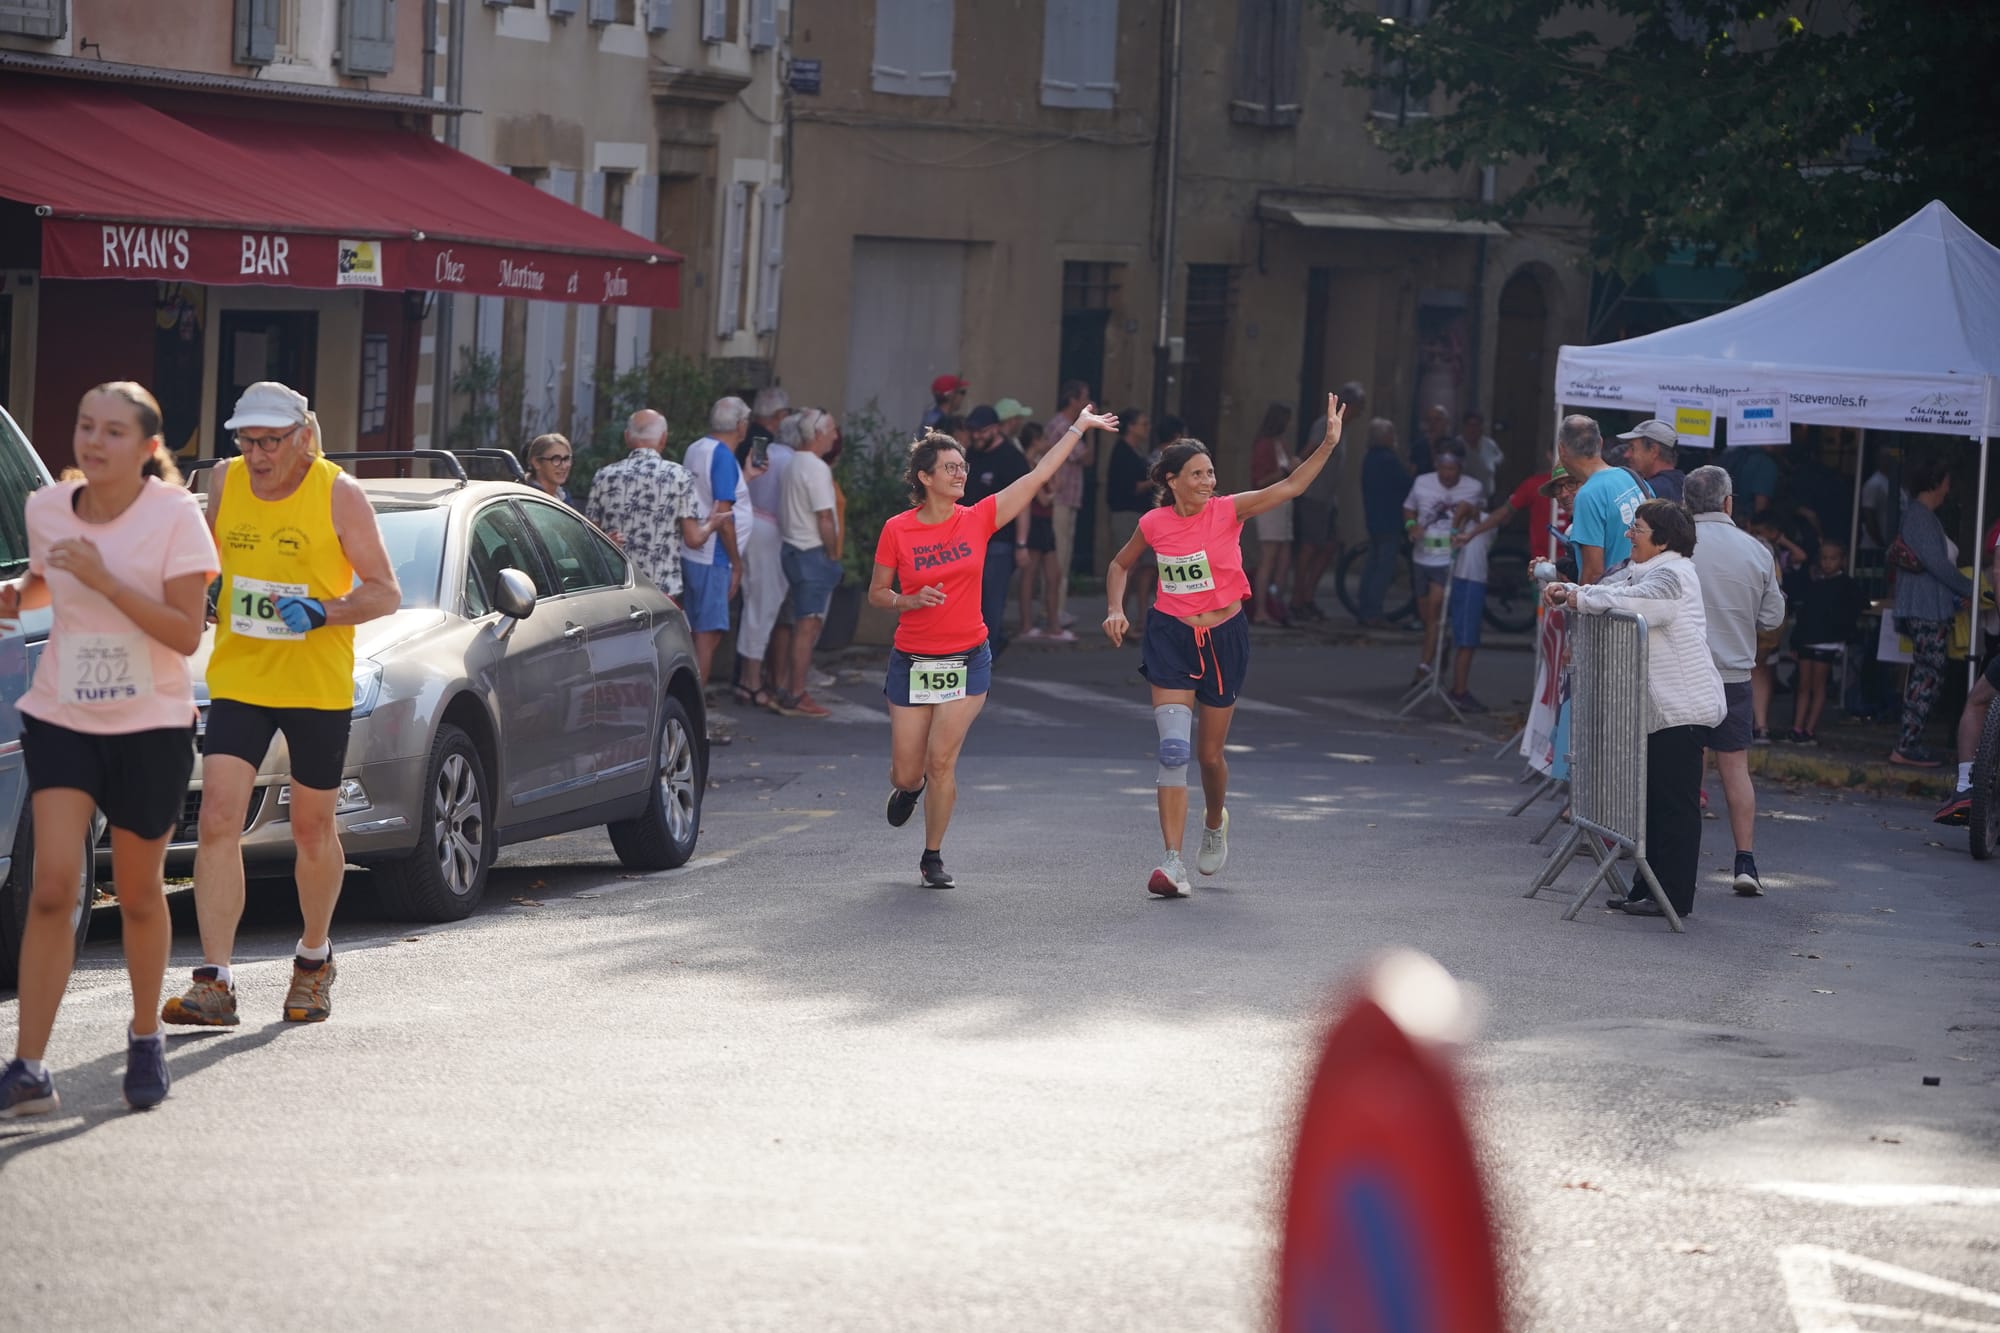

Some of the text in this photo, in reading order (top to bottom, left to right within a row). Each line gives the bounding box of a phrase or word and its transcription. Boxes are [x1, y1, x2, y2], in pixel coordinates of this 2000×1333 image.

[102, 225, 289, 275] RYAN'S BAR
[436, 249, 628, 302] Chez Martine et John
[912, 543, 943, 555] 10KM
[914, 542, 972, 572] PARIS
[1164, 564, 1203, 581] 116
[241, 593, 274, 619] 16
[77, 660, 132, 685] 202
[919, 672, 959, 690] 159
[73, 684, 136, 701] TUFF'S
